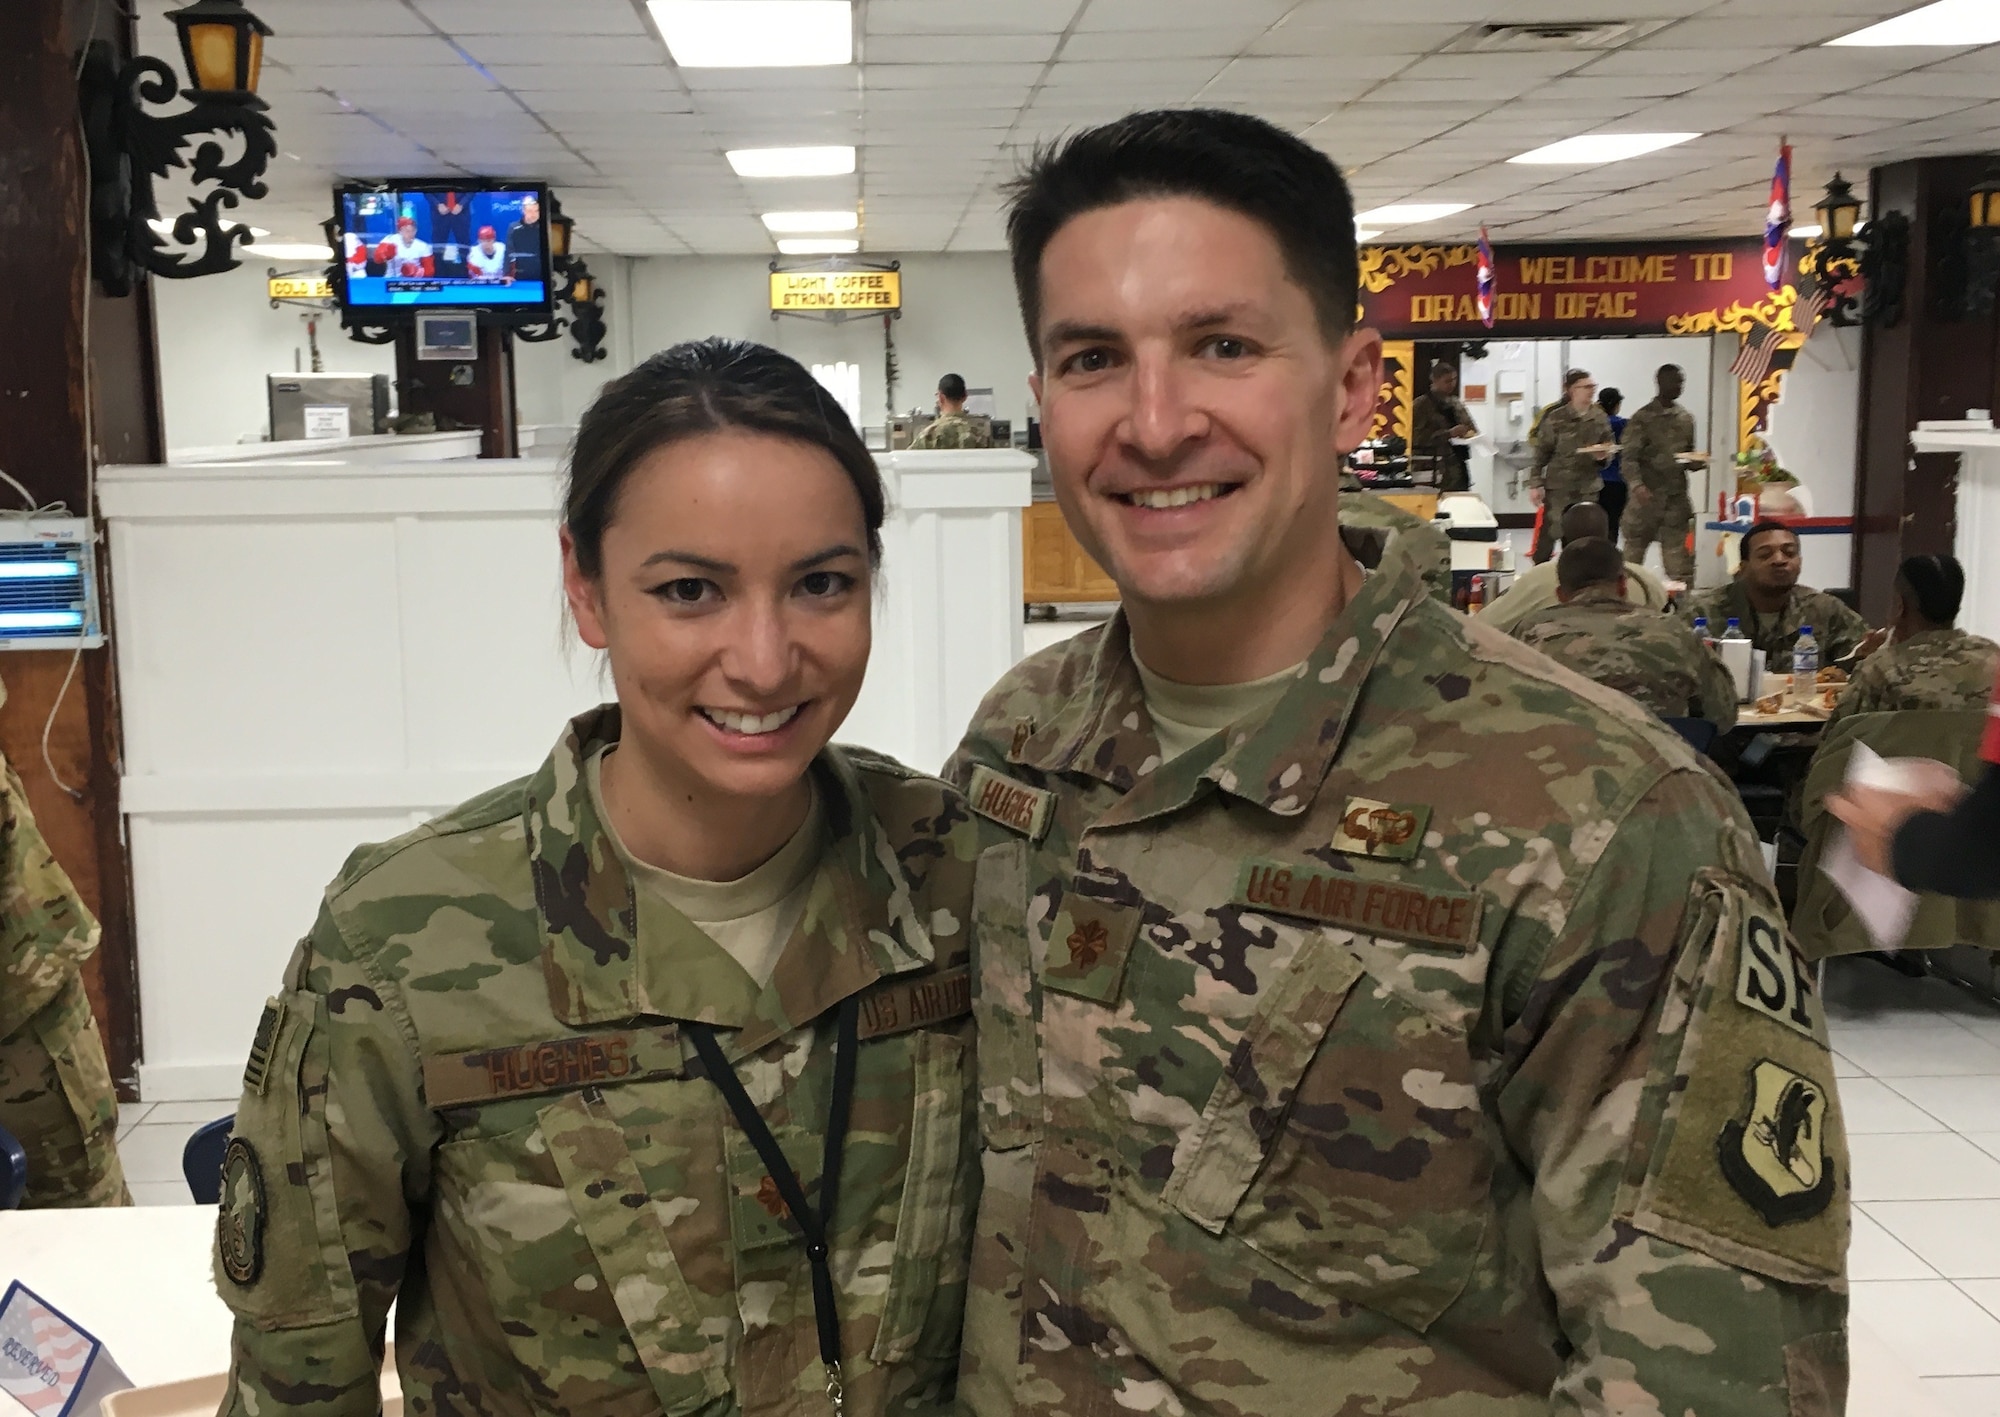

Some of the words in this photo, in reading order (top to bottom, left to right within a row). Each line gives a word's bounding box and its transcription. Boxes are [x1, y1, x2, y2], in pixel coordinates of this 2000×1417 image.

[788, 277, 826, 289] LIGHT
[835, 275, 884, 288] COFFEE
[1519, 254, 1677, 285] WELCOME
[1690, 252, 1733, 281] TO
[274, 282, 308, 294] COLD
[316, 282, 335, 294] BE
[782, 292, 835, 305] STRONG
[841, 291, 891, 304] COFFEE
[1411, 293, 1542, 323] DRAON
[1555, 291, 1638, 320] DFAC
[1300, 874, 1356, 919] AIR
[1362, 884, 1468, 939] FORCE
[486, 1037, 630, 1095] HUGHES
[2, 1337, 60, 1387] RESERVED
